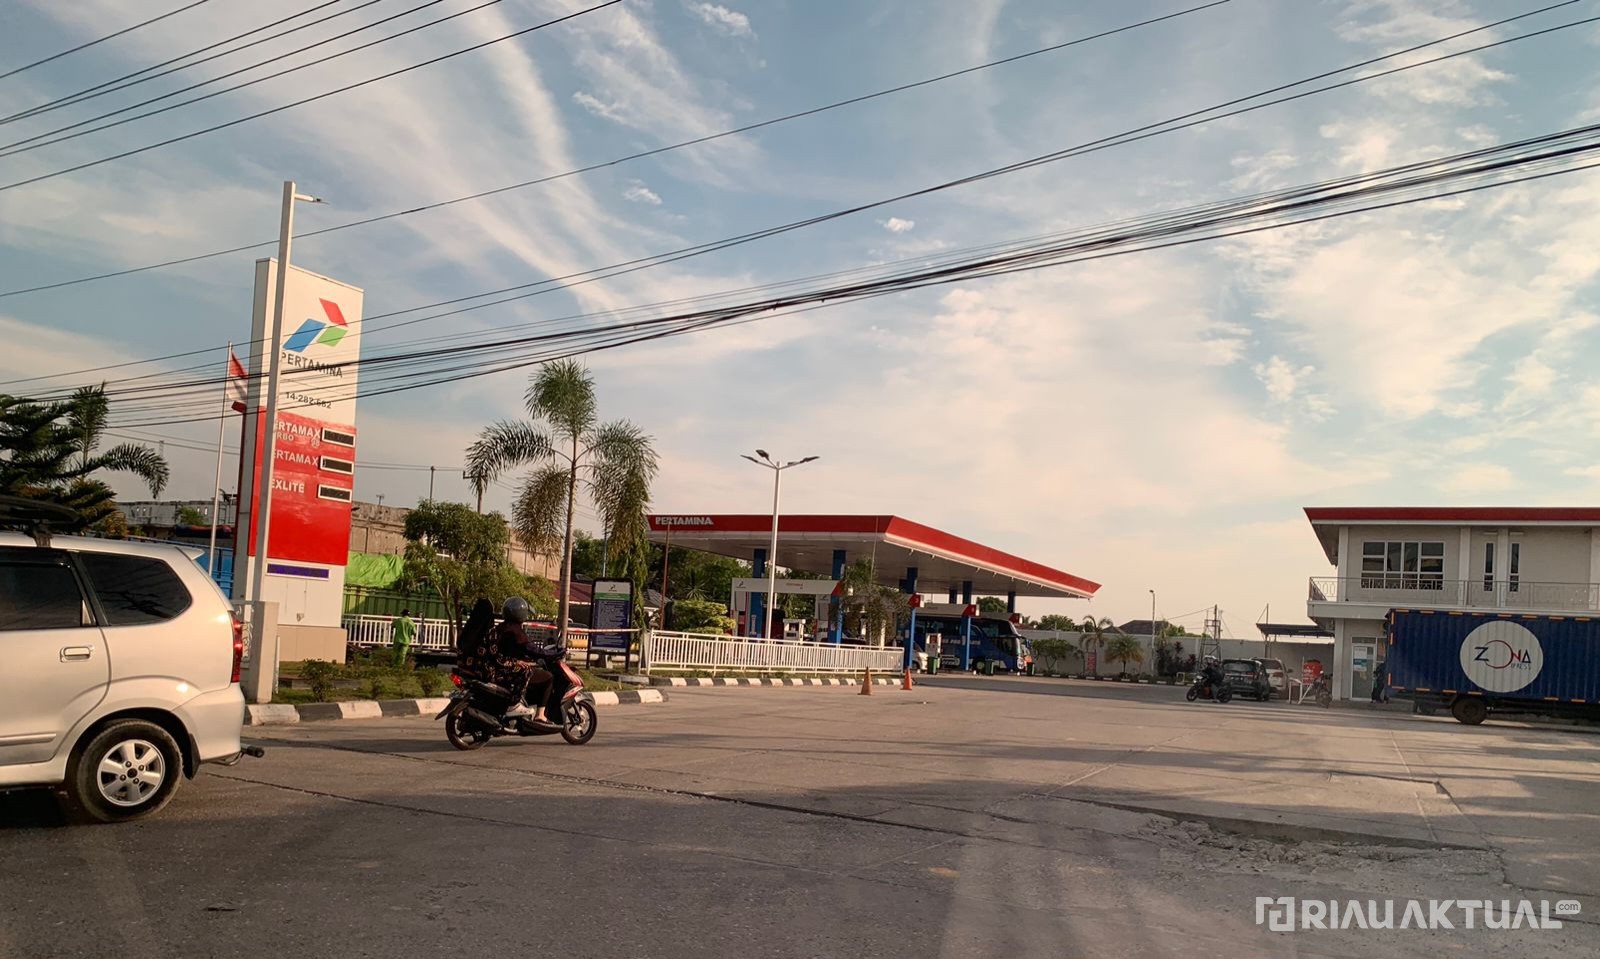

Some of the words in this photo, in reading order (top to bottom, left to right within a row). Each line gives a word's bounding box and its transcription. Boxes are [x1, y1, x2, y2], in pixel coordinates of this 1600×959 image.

[281, 352, 343, 378] PERTAMINA
[273, 421, 321, 439] ERTAMAX
[271, 479, 305, 494] EXLITE
[655, 516, 714, 525] PERTAMINA
[1474, 640, 1531, 669] ZONA
